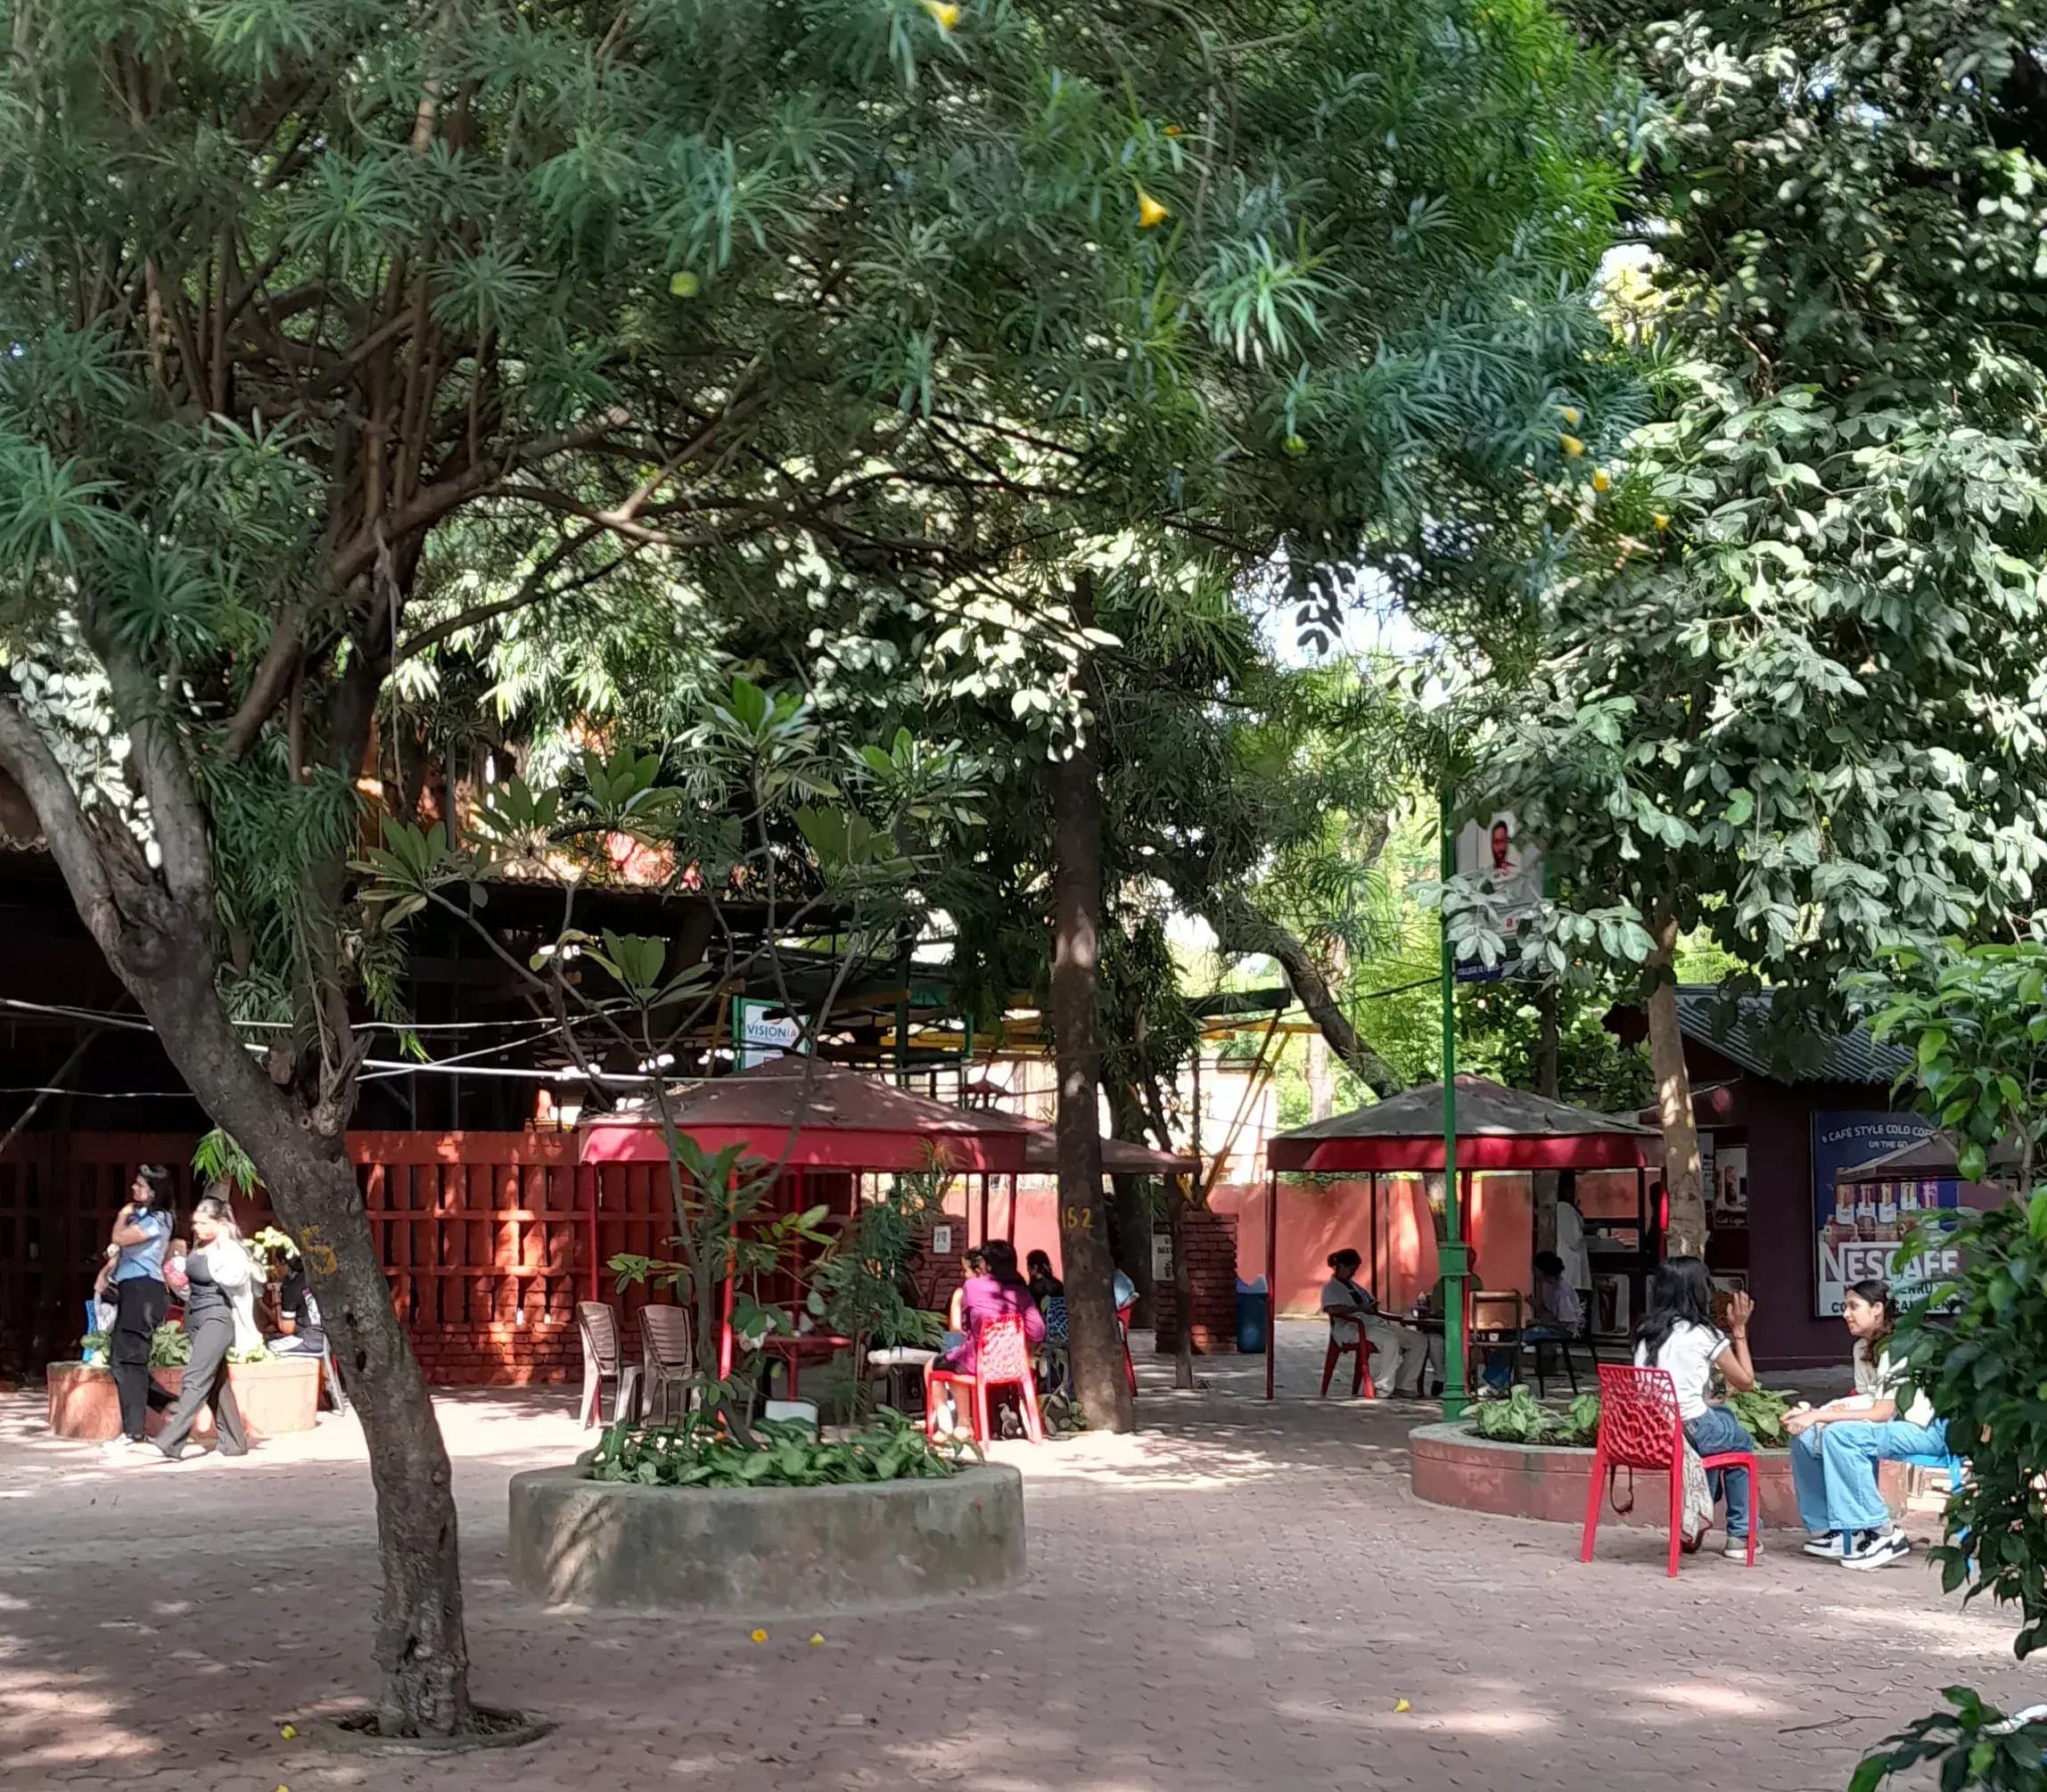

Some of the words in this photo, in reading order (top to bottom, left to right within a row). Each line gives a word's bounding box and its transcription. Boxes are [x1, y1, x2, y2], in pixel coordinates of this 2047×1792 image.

[1855, 1124, 1883, 1137] STYLE
[1886, 1124, 1911, 1135] COLD
[1880, 1140, 1895, 1148] THE
